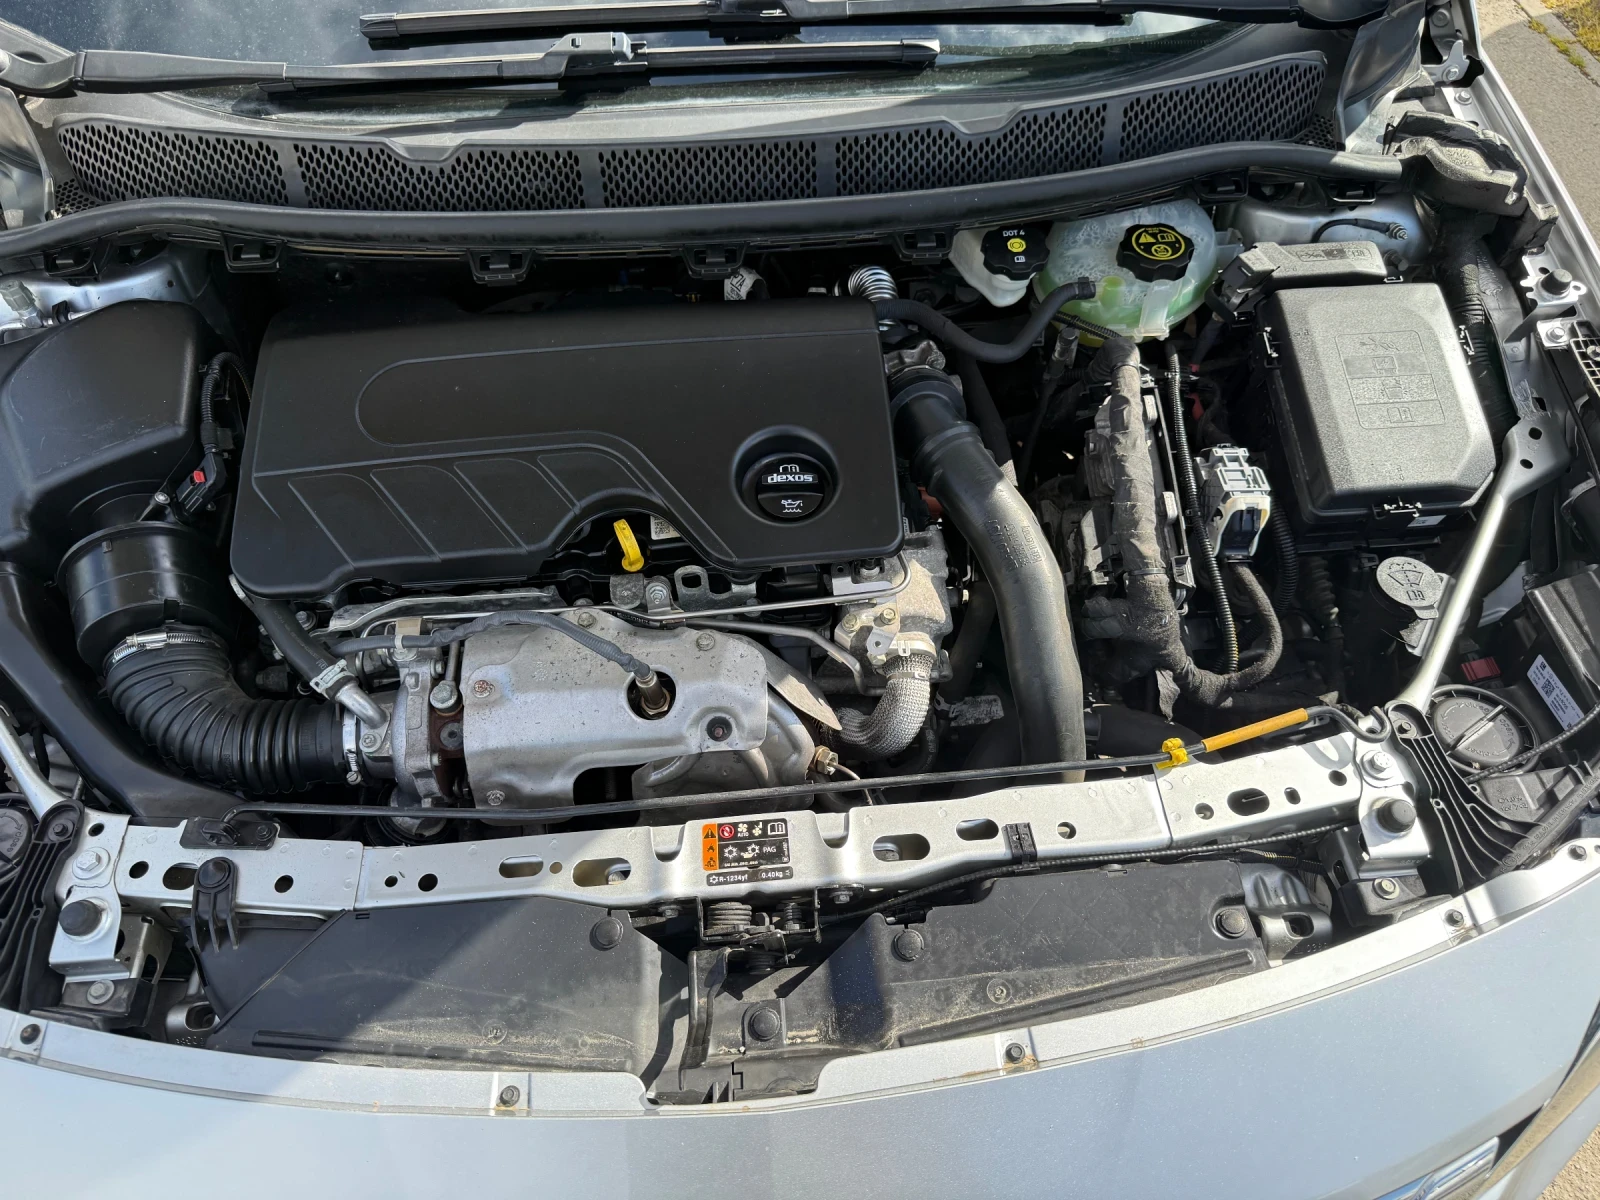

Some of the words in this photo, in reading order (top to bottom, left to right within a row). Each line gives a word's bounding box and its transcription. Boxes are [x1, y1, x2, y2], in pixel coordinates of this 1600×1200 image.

[767, 473, 814, 484] dexos
[1499, 718, 1514, 737] open
[6, 831, 22, 853] close
[719, 873, 748, 883] R-1234yf
